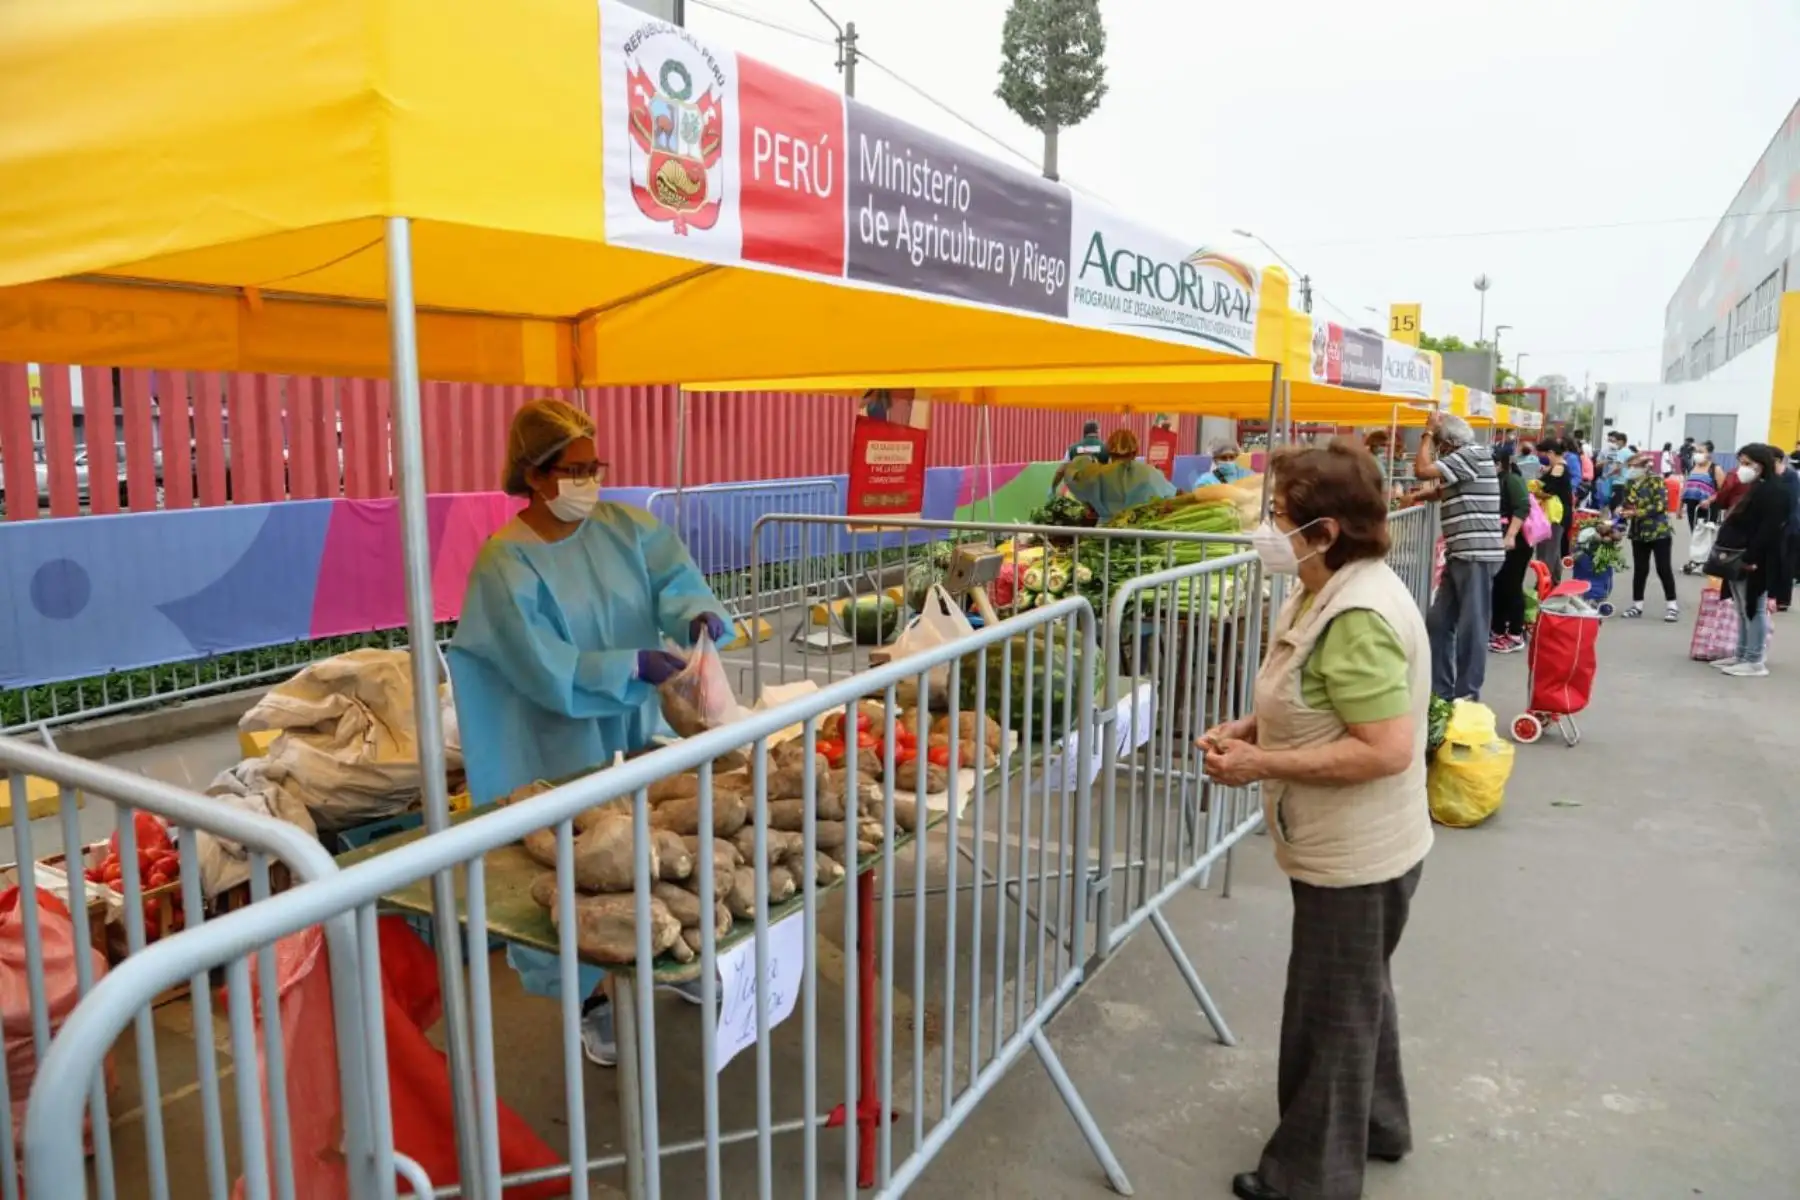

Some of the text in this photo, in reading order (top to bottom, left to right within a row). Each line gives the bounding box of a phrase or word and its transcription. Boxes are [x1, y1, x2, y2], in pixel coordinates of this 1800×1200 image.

[754, 126, 833, 198] PERÚ
[860, 133, 970, 213] Ministerio
[860, 193, 1065, 295] de Agricultura y Riego
[1074, 286, 1121, 312] PROGRAMA
[1123, 298, 1133, 314] DE
[1391, 314, 1414, 332] 15
